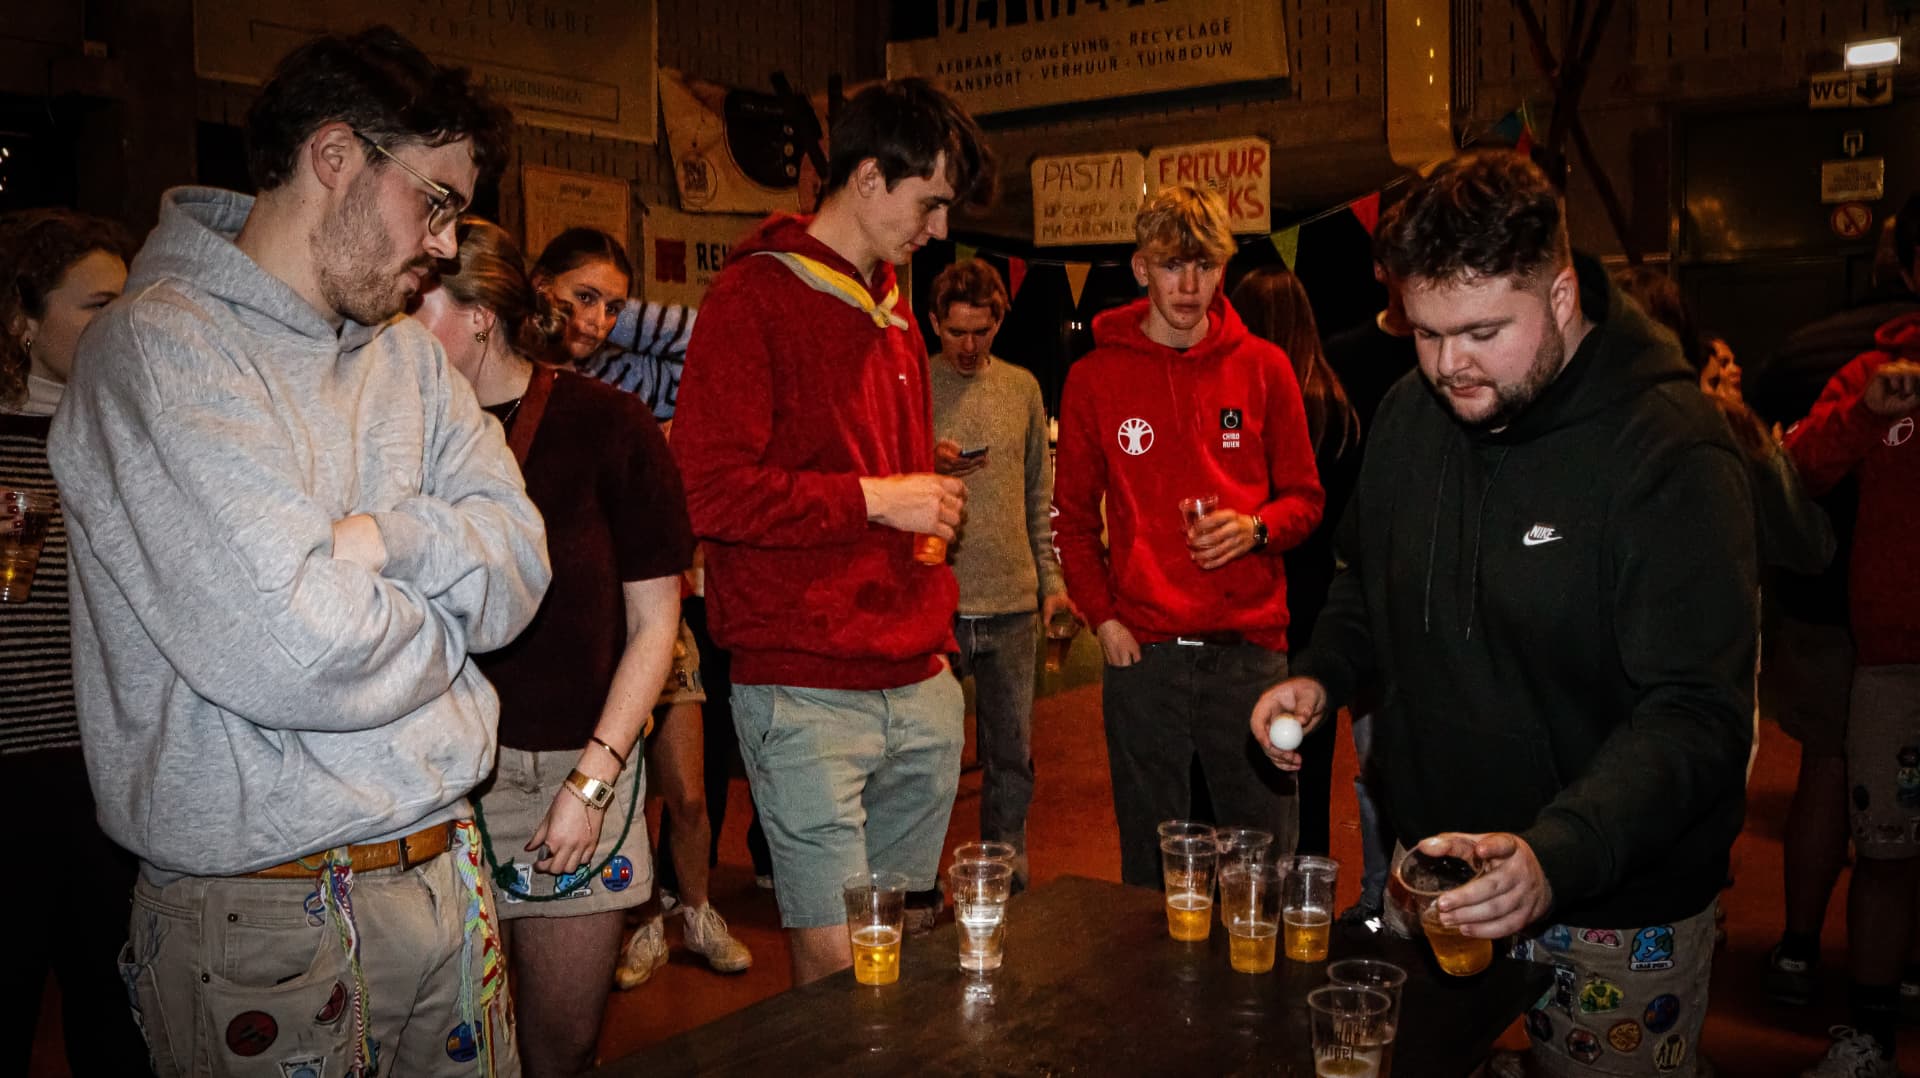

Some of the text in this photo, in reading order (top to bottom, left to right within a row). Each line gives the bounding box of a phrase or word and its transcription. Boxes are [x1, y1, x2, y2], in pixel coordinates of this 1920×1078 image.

[937, 53, 1001, 75] AFBRAAK
[1022, 38, 1109, 61] OMGEVING
[1130, 16, 1232, 45] RECYCLAGE
[954, 41, 1234, 92] ANSPORT VERHUUR TUINBOUW
[1812, 80, 1849, 100] WC
[1043, 156, 1123, 191] PASTA
[1159, 147, 1266, 184] FRITUUR
[1530, 524, 1556, 539] NIKE
